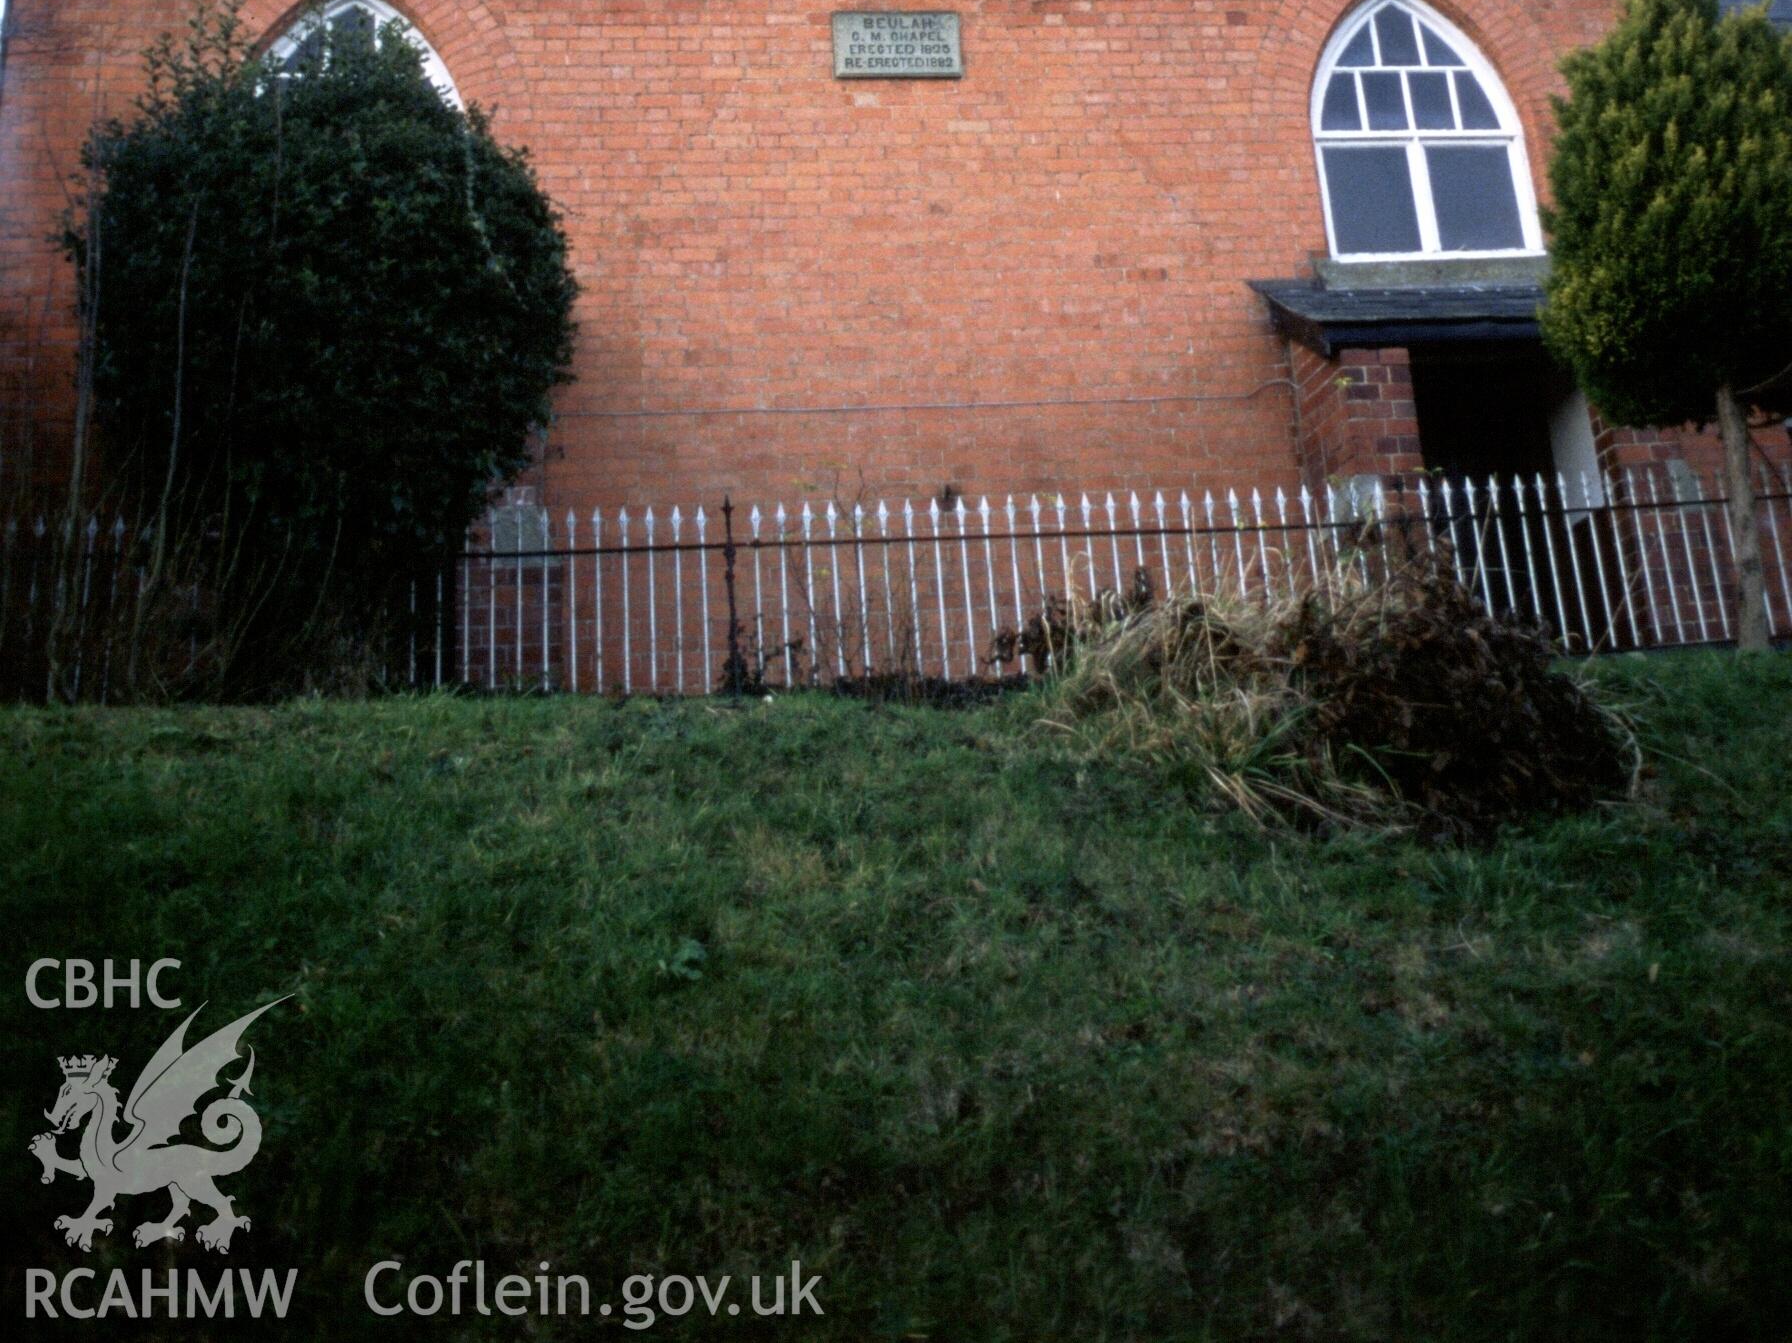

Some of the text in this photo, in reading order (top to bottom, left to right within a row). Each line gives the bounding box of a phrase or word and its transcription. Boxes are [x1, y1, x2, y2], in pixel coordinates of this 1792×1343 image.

[863, 18, 932, 29] BEULAH
[891, 32, 944, 42] CHAPEL
[849, 44, 914, 54] ERECTED
